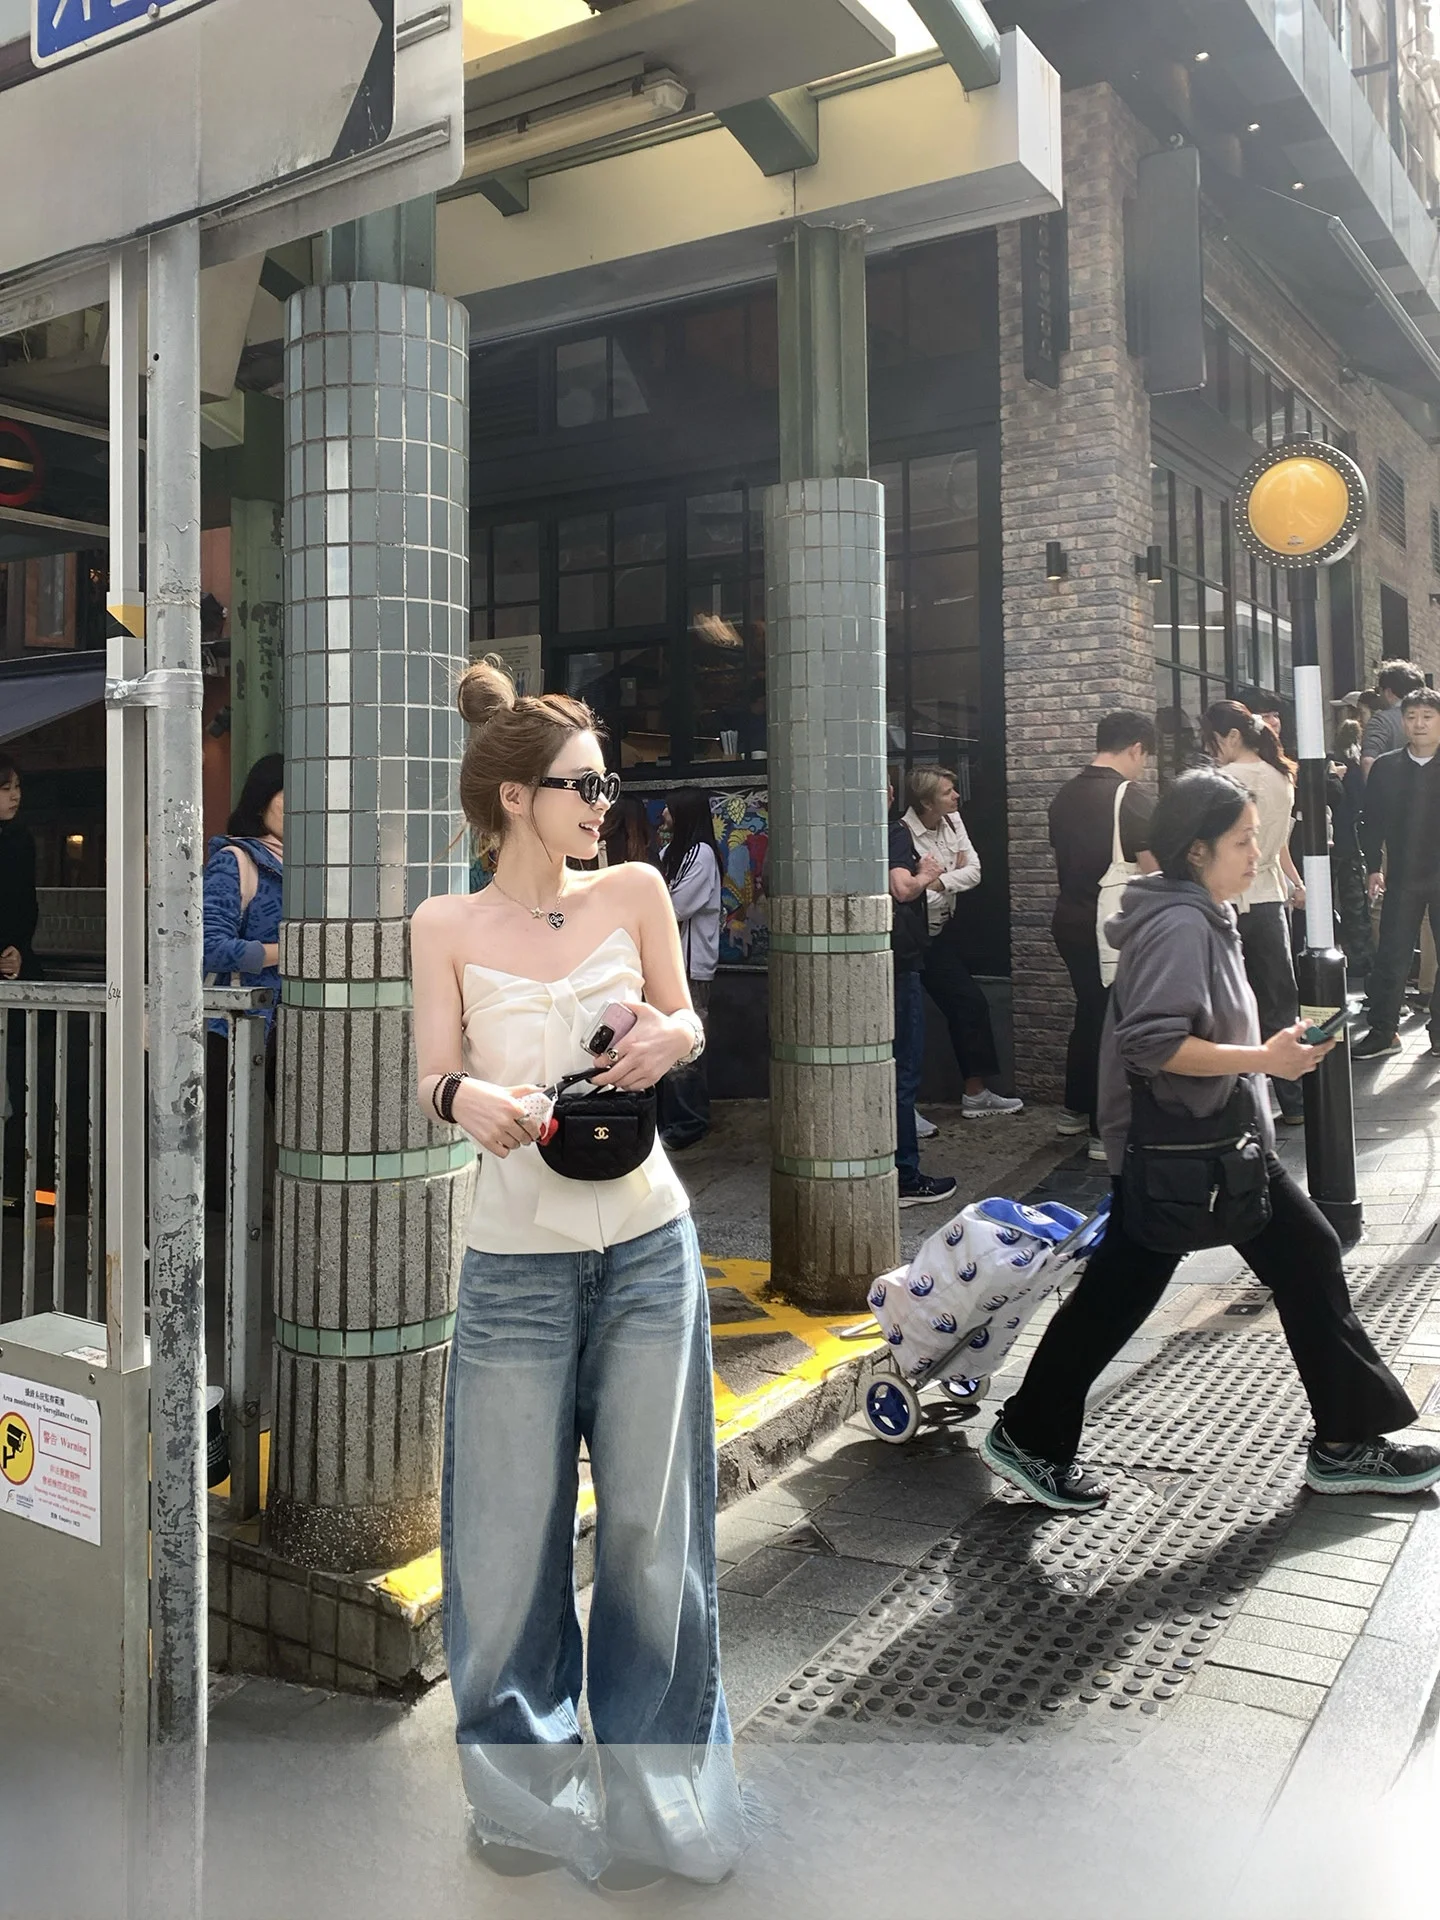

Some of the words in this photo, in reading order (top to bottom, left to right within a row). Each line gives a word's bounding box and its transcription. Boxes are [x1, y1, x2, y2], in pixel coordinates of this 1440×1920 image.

[3, 1394, 13, 1402] Area
[14, 1398, 36, 1409] monitored
[36, 1402, 42, 1412] by
[42, 1405, 70, 1419] Surveillance
[70, 1413, 88, 1425] Camera
[43, 1430, 57, 1446] 警告
[60, 1436, 87, 1456] Warning
